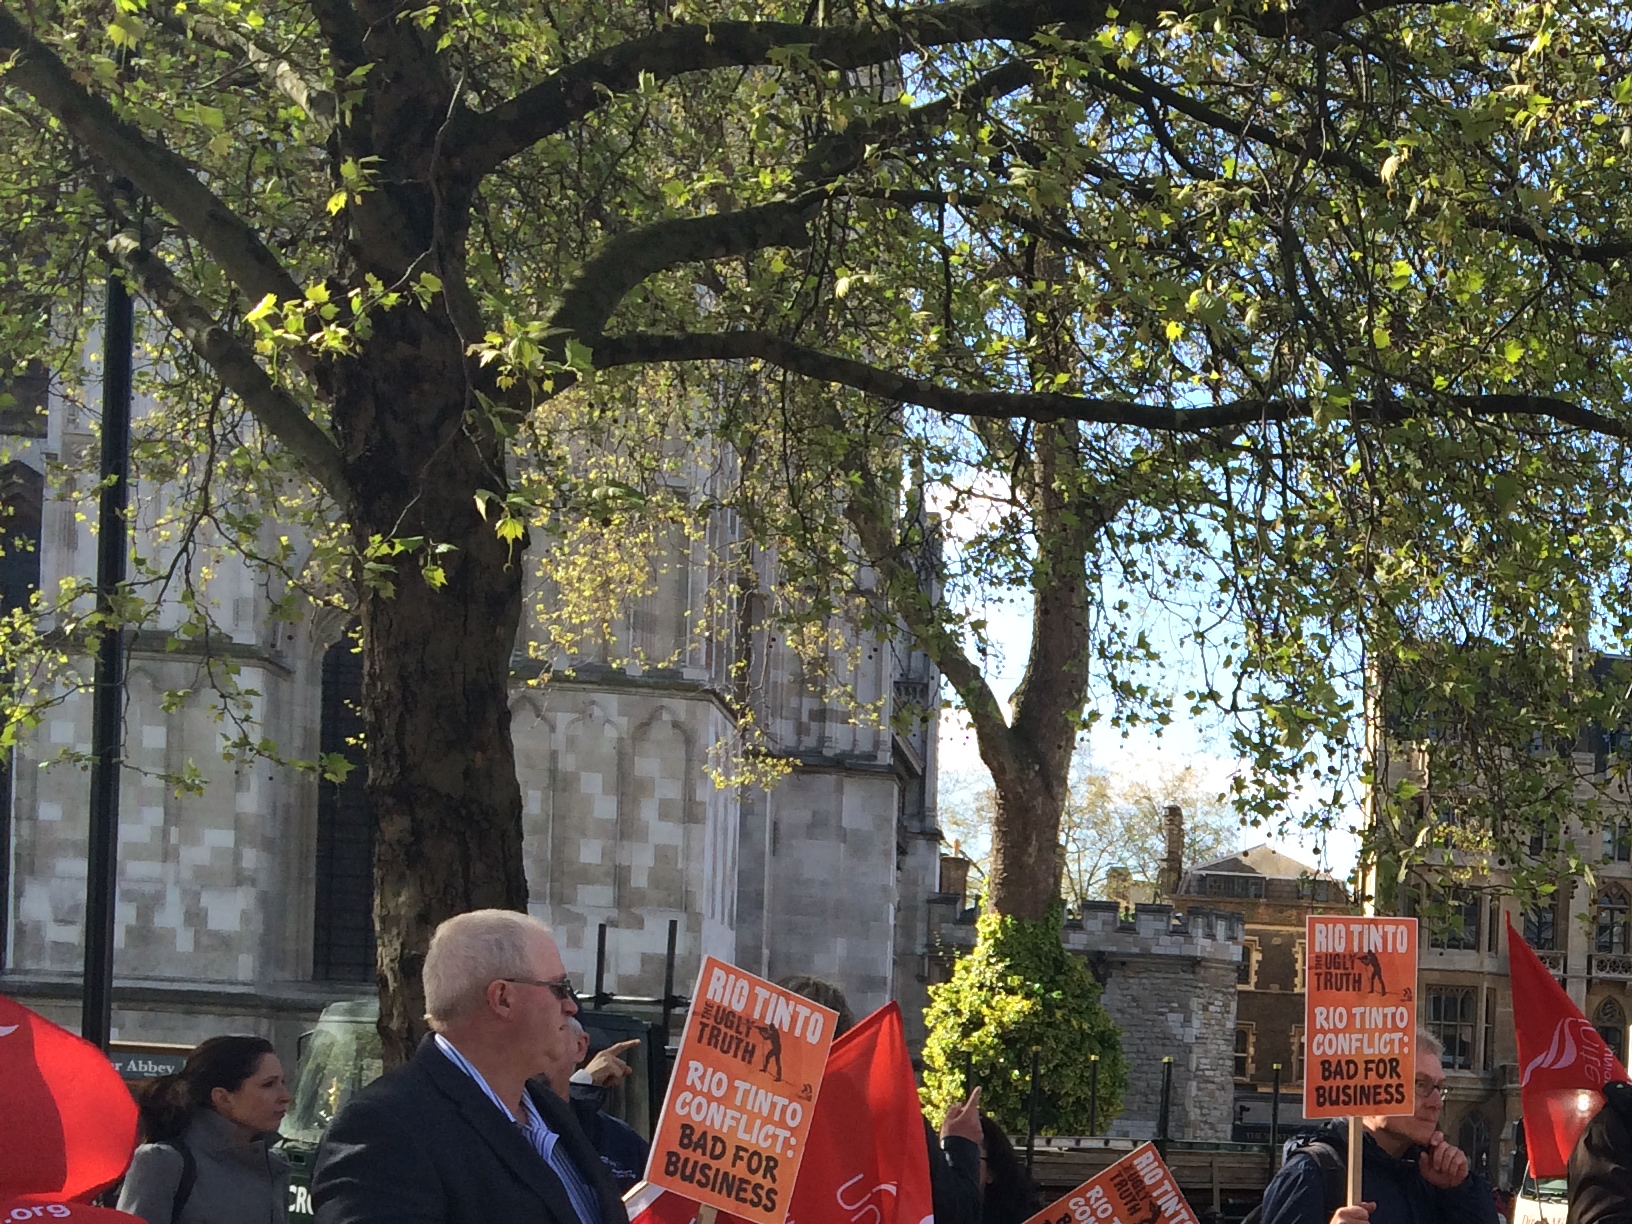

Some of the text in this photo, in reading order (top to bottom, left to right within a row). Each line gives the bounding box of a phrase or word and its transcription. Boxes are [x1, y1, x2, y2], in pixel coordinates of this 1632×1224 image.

[1314, 923, 1408, 954] RIO TINTO
[1324, 953, 1357, 971] UGLY
[1315, 972, 1362, 992] TRUTH
[707, 967, 824, 1045] RIO TINTO
[714, 1005, 756, 1039] UGLY
[1314, 1006, 1408, 1031] RIO TINTO
[696, 1021, 757, 1066] TRUTH
[1312, 1032, 1409, 1056] CONFLICT:
[126, 1059, 175, 1074] Abbey
[1320, 1057, 1401, 1081] BAD FOR
[686, 1060, 803, 1128] RIO TINTO
[1315, 1083, 1405, 1107] BUSINESS
[675, 1091, 797, 1158] CONFLICT:
[678, 1124, 779, 1184] BAD FOR
[1133, 1150, 1164, 1185] RIO
[664, 1151, 778, 1213] BUSINESS
[1110, 1170, 1142, 1216] TRUTH
[1086, 1185, 1113, 1219] RIO
